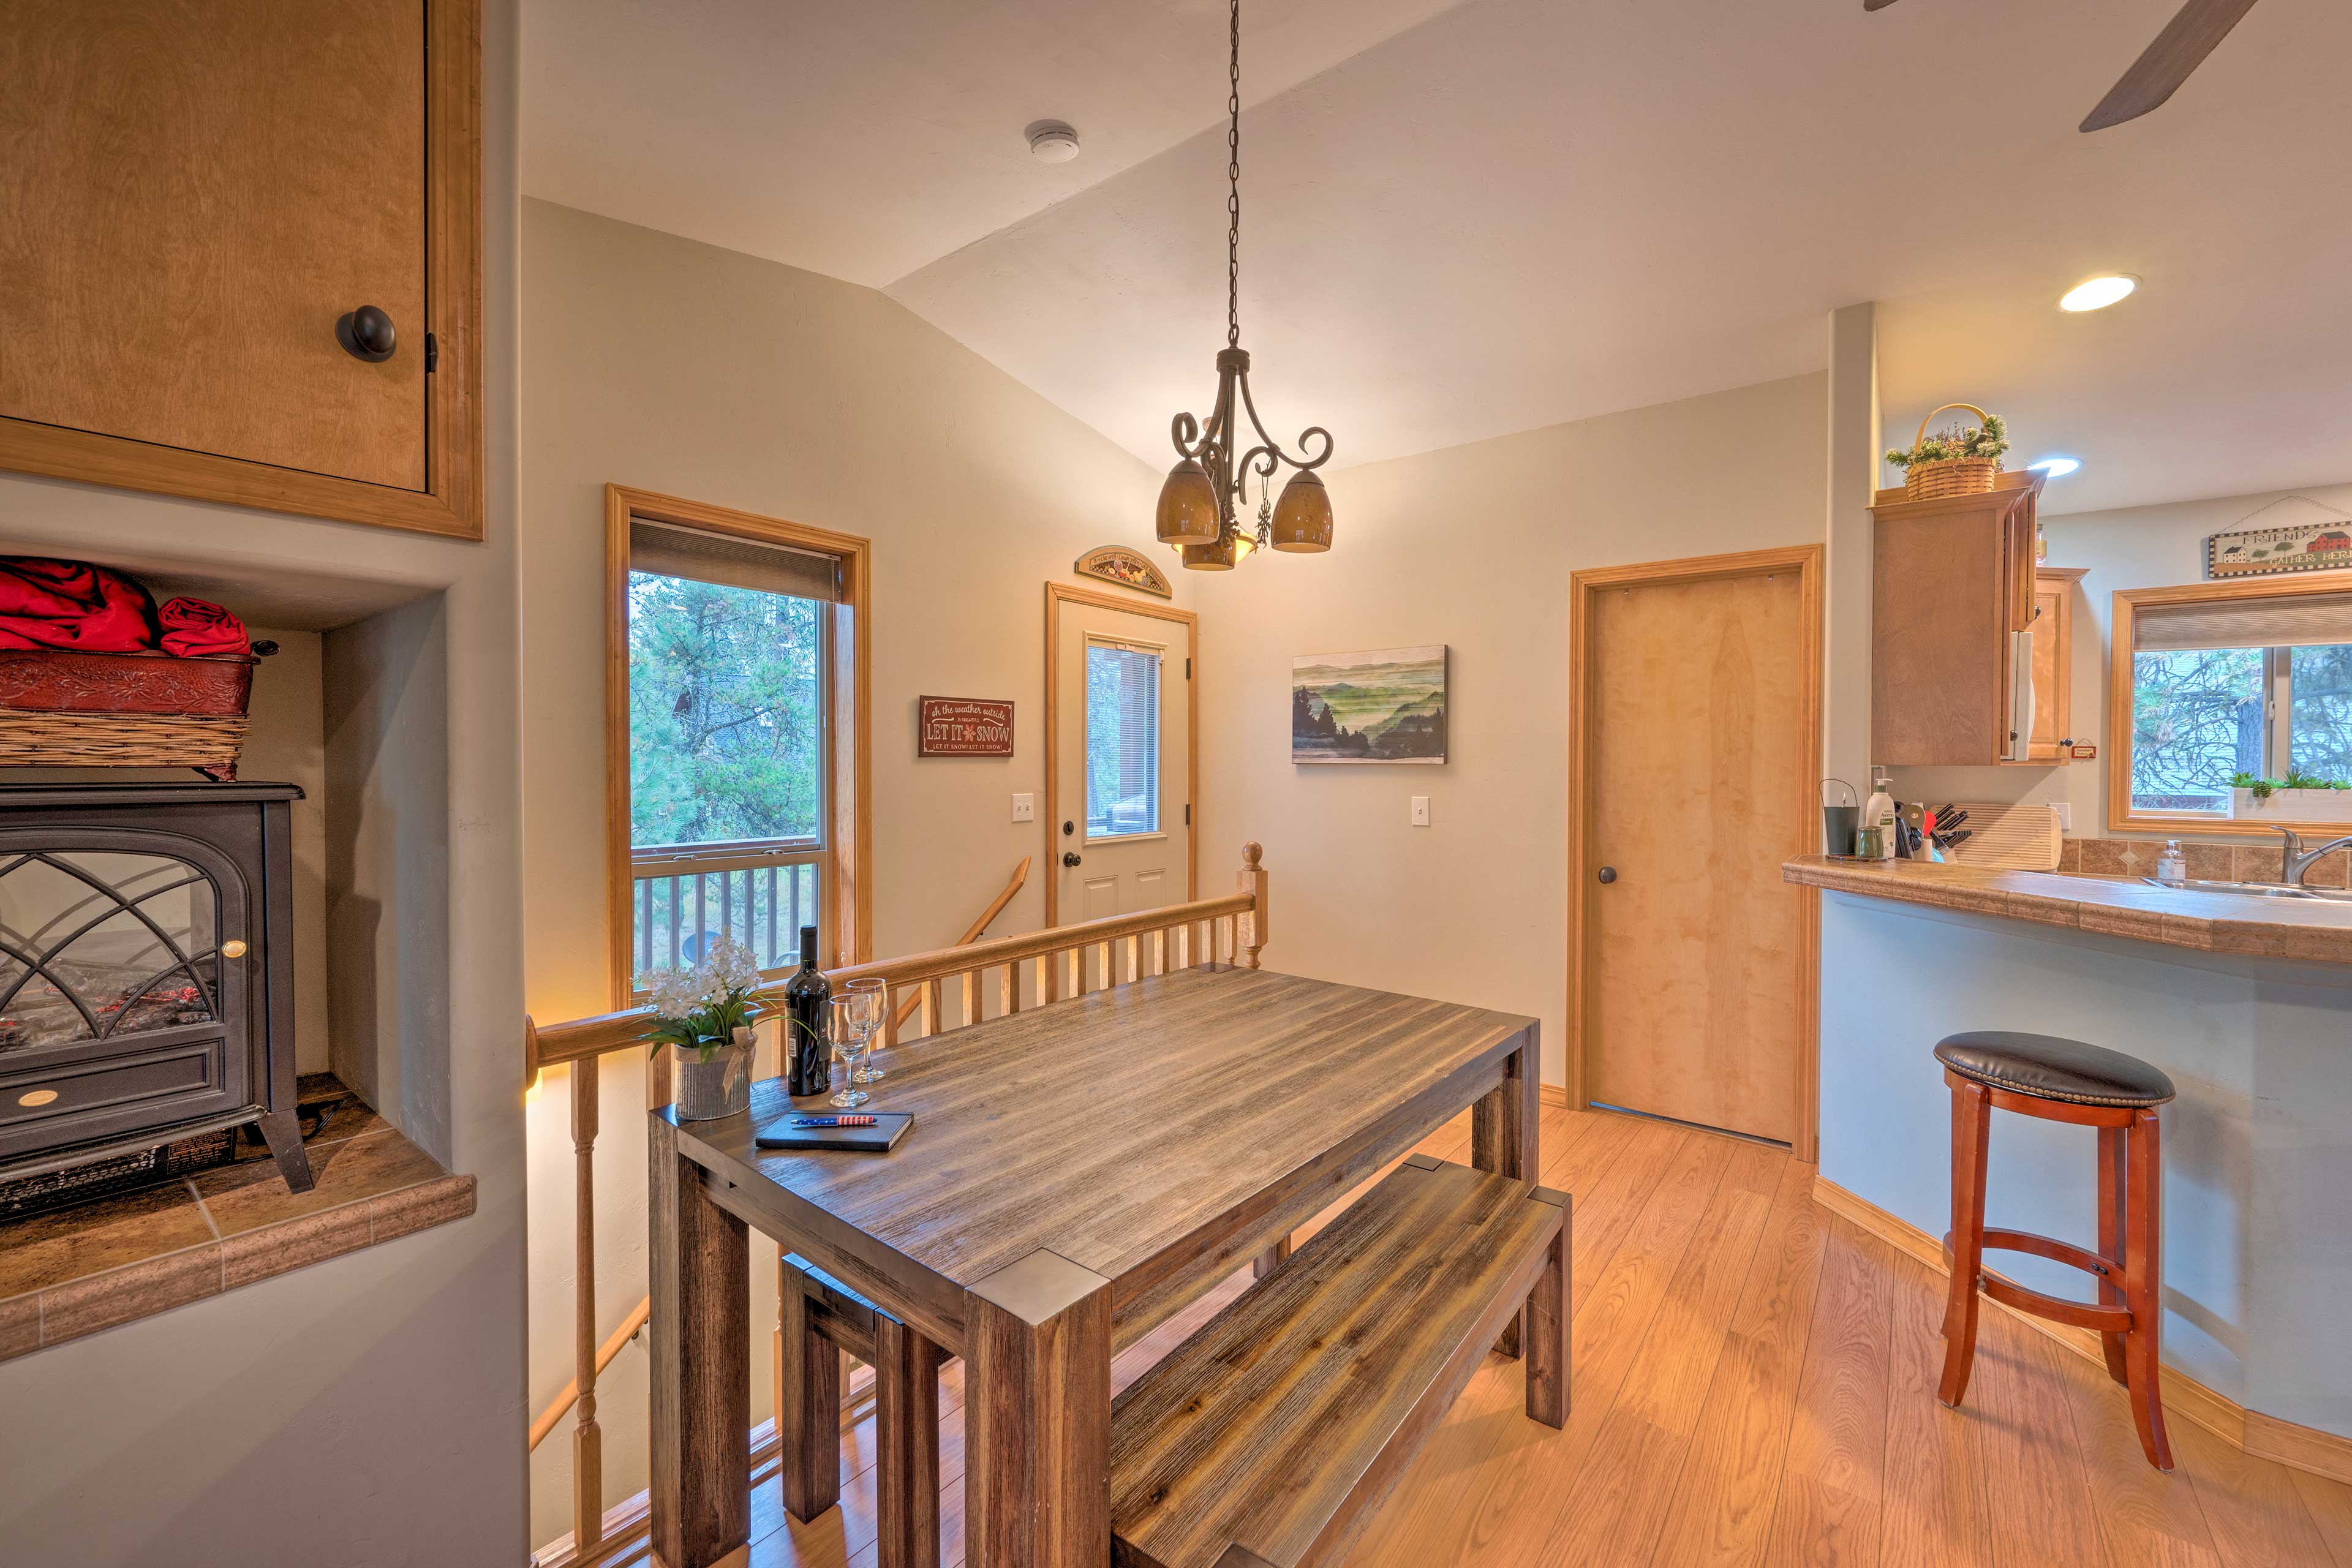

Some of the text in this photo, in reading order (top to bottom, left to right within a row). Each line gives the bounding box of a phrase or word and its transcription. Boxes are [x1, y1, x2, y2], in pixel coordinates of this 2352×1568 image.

[2242, 529, 2318, 545] FRIENDS
[2269, 554, 2316, 568] GATHER
[932, 703, 1005, 720] oh the weather outside
[927, 723, 1010, 742] LET IT SNOW
